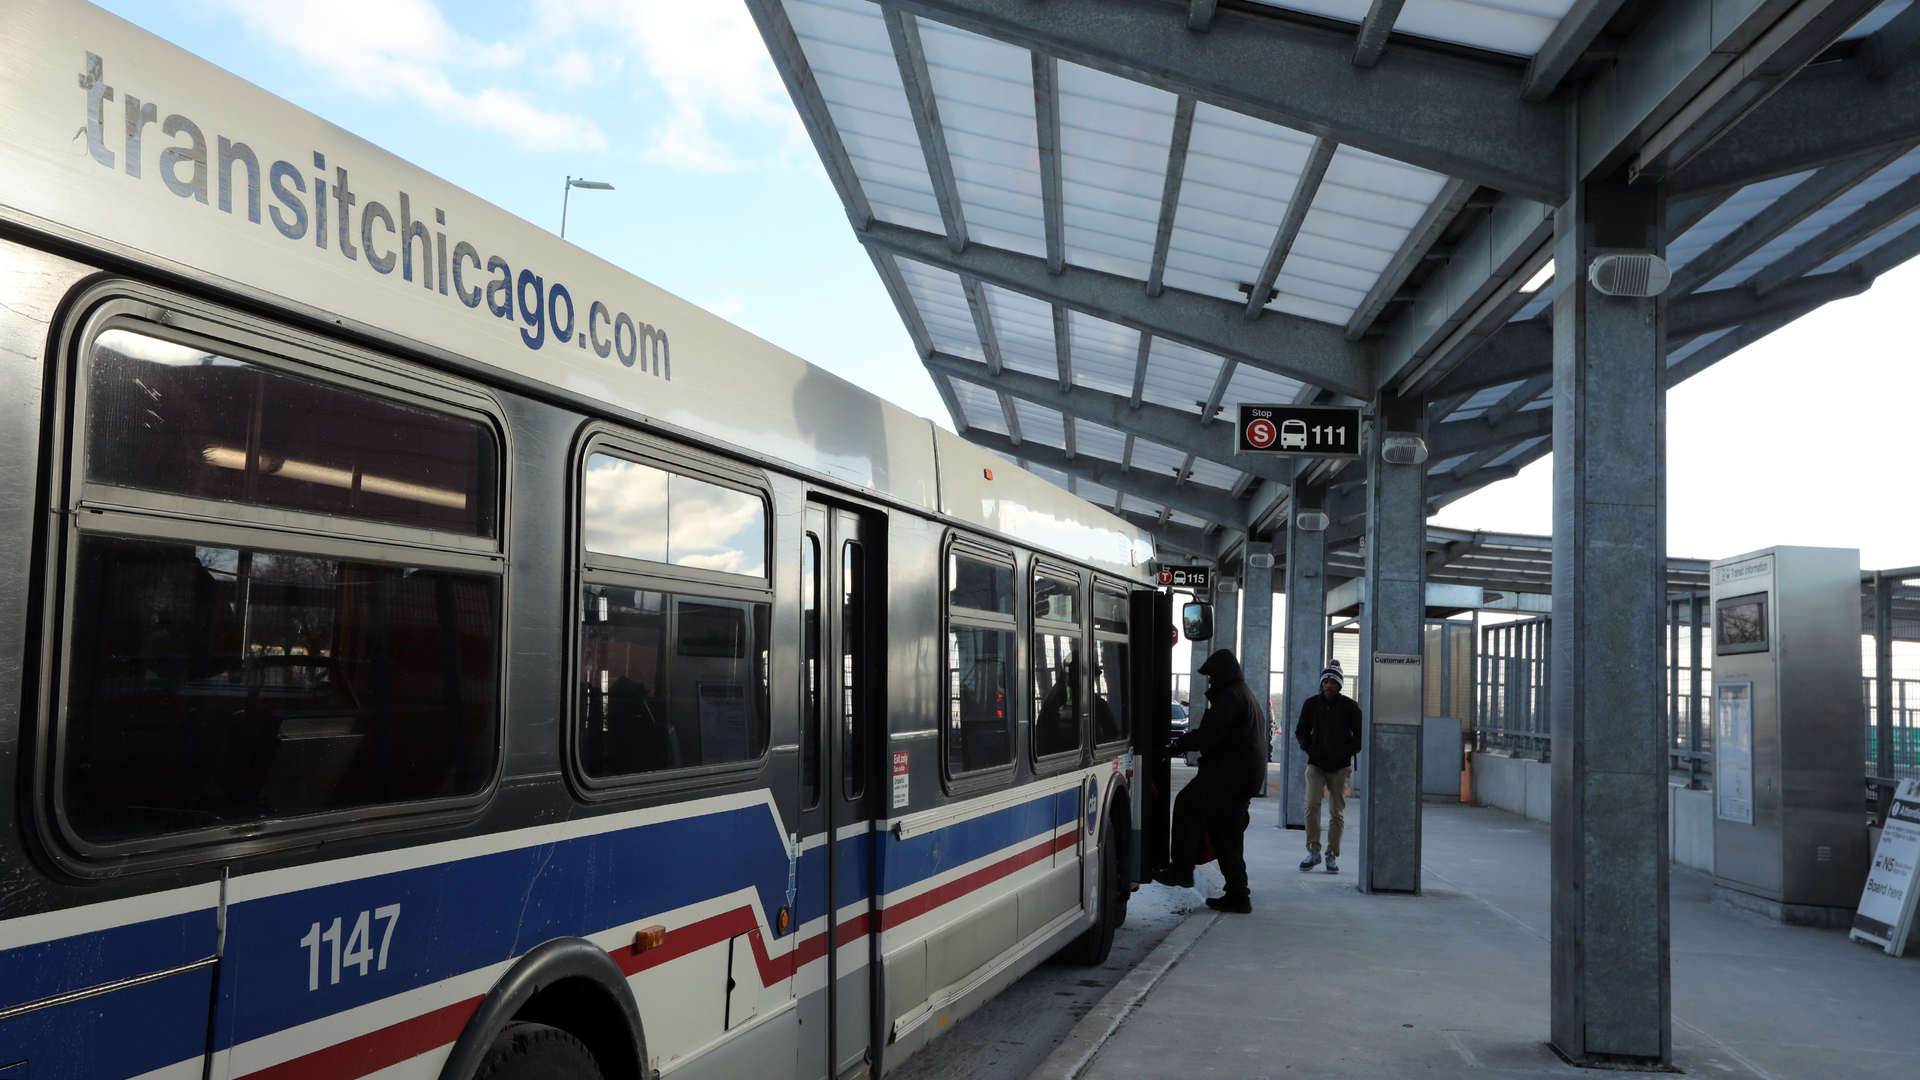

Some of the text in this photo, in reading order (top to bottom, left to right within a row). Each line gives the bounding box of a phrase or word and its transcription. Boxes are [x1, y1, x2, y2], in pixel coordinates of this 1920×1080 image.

[78, 51, 671, 381] transitchicago.com
[1252, 409, 1272, 418] Stop
[1253, 424, 1345, 445] S 111
[1187, 573, 1205, 584] 115
[1374, 656, 1421, 666] Customer Alert
[1882, 857, 1895, 872] N5
[1867, 879, 1903, 900] Board here
[301, 903, 400, 991] 1147
